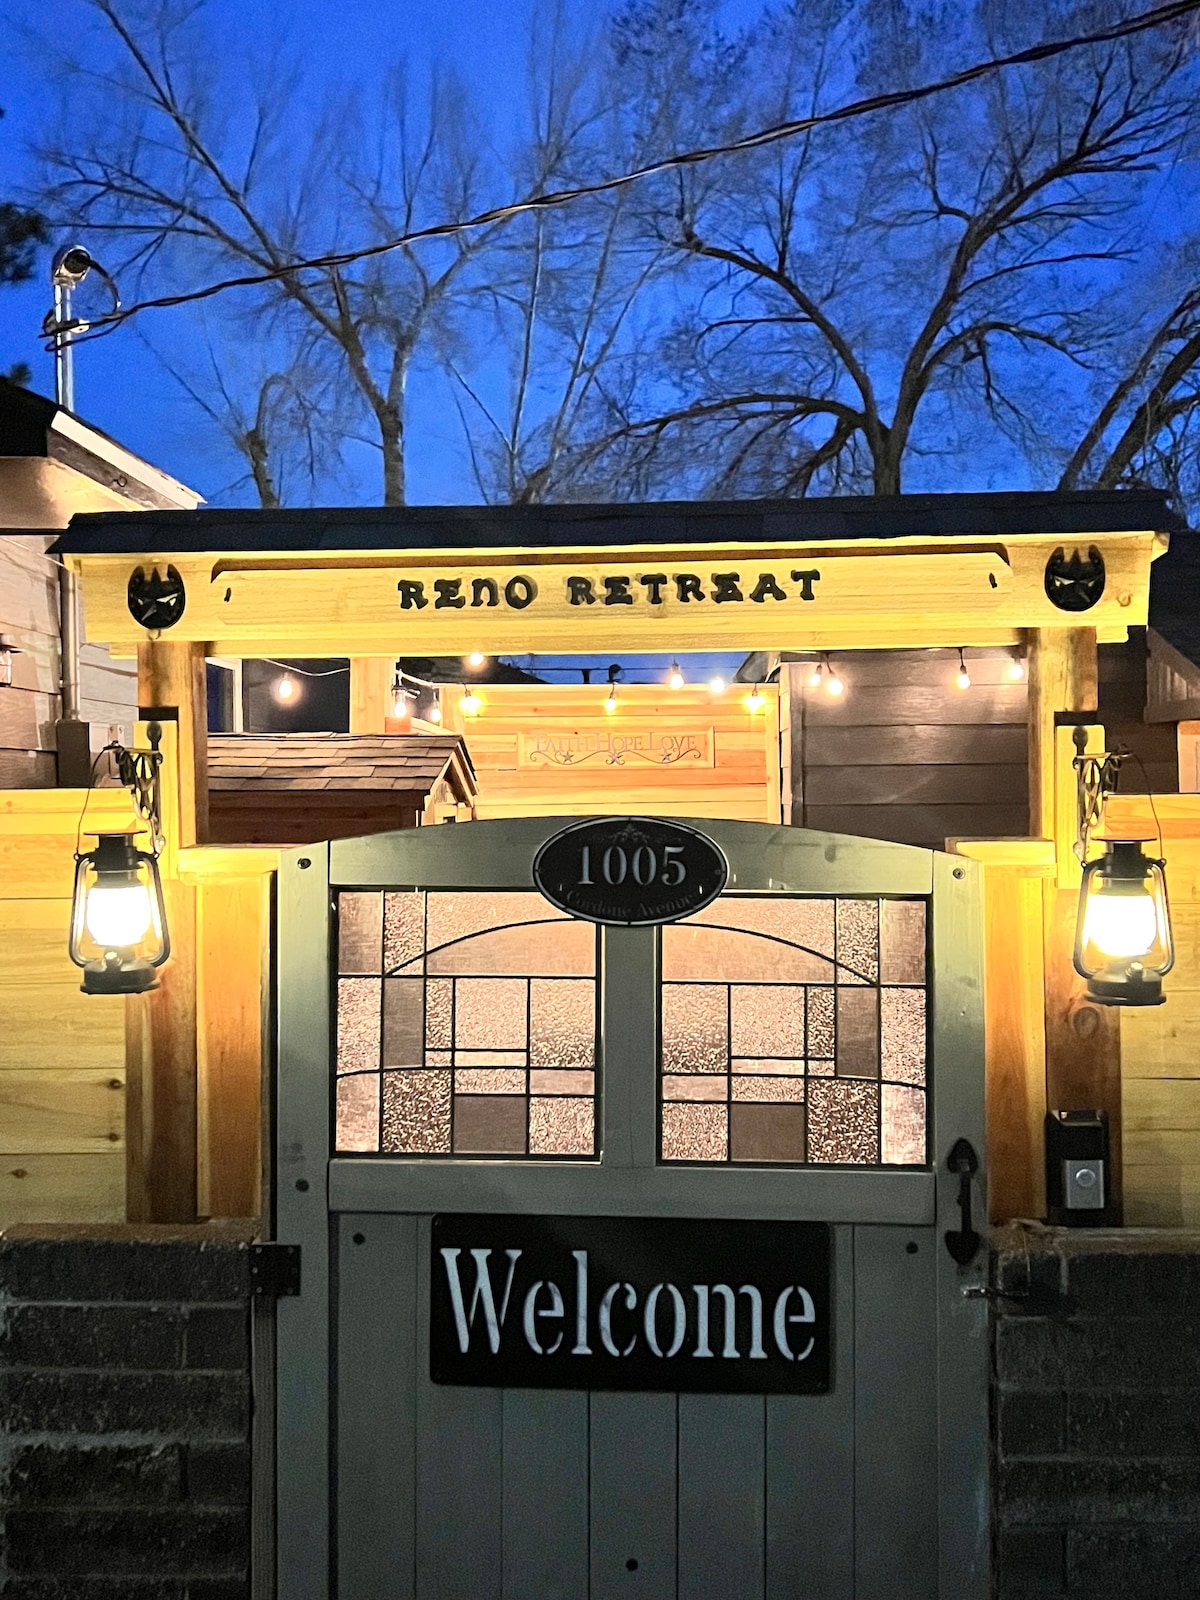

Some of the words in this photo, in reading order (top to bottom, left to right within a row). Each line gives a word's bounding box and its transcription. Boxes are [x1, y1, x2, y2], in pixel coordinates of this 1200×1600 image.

[568, 570, 820, 606] RETREAT
[595, 732, 643, 751] HOPE
[648, 731, 698, 752] LOVE
[577, 846, 687, 886] 1005
[636, 893, 694, 919] Avenue
[440, 1247, 816, 1361] Welcome
